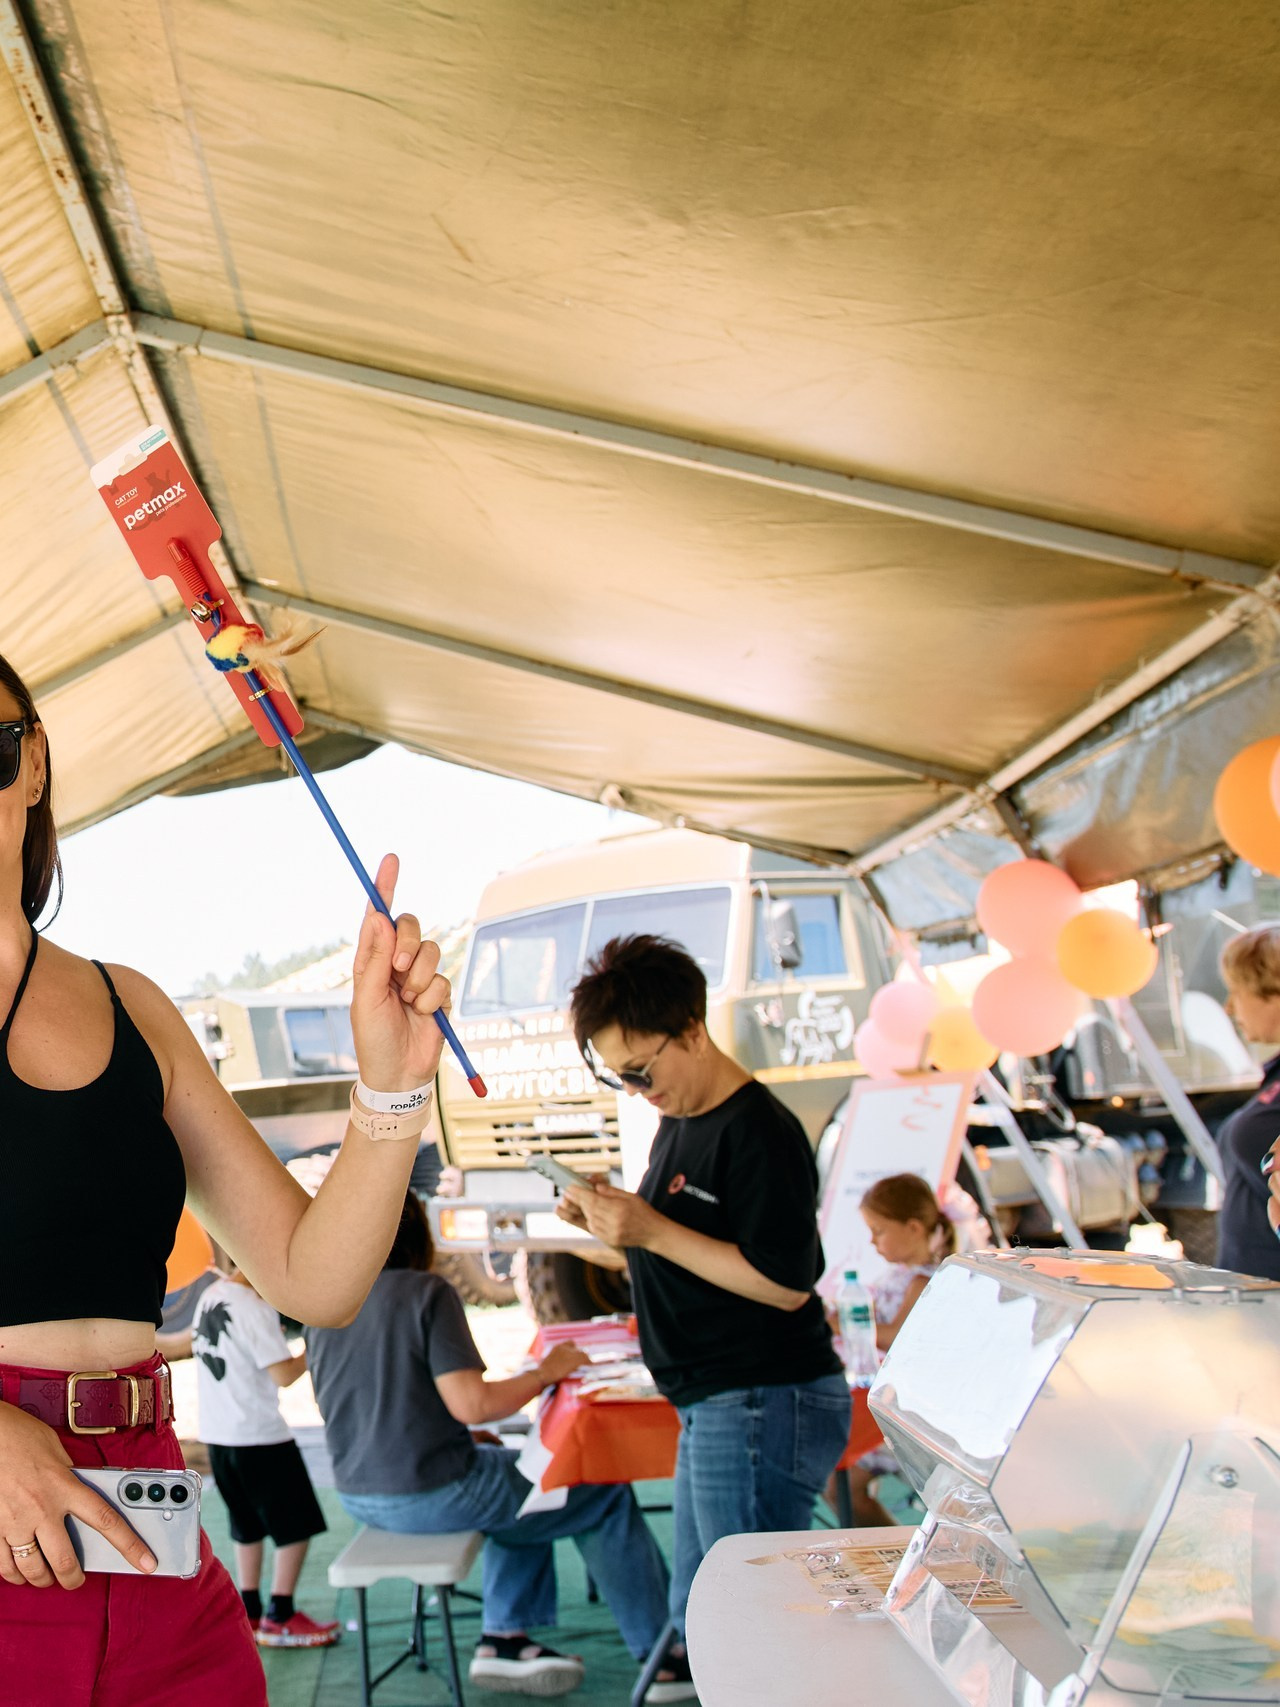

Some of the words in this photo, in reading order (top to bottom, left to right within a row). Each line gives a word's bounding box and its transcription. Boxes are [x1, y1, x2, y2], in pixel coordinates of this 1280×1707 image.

[114, 493, 128, 506] CAT
[126, 487, 138, 498] TOY
[123, 481, 186, 530] petmax
[410, 1093, 422, 1102] ЗА
